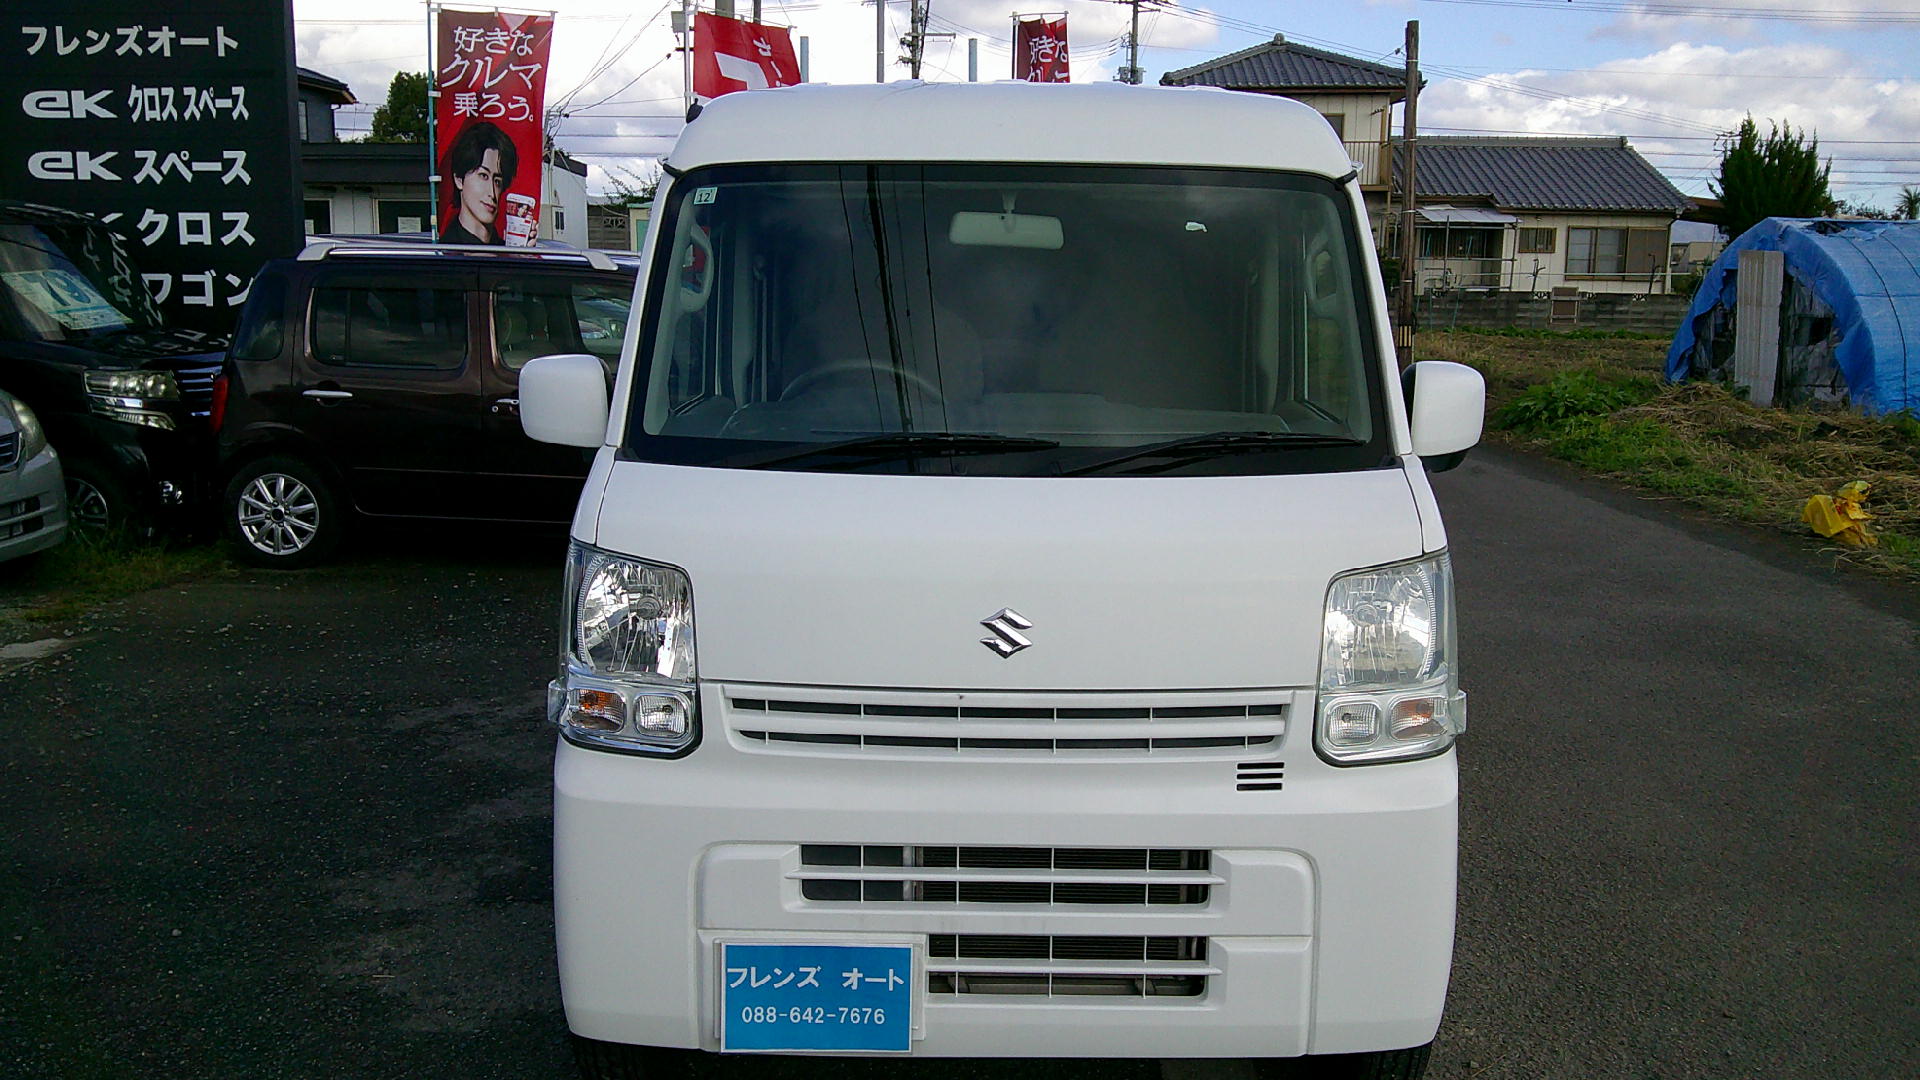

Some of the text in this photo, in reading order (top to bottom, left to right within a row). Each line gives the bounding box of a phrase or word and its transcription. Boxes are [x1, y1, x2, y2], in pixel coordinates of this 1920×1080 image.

[21, 25, 239, 57] フレンズオート
[453, 25, 535, 57] 好きな
[441, 53, 542, 90] クルマ
[453, 91, 534, 123] 乗ろう。
[132, 150, 252, 186] スペース
[698, 192, 711, 202] 12
[136, 208, 256, 247] クロス
[140, 269, 255, 307] ワゴン
[727, 965, 905, 991] フレンズ オート
[741, 1006, 886, 1025] 088-642-7676
